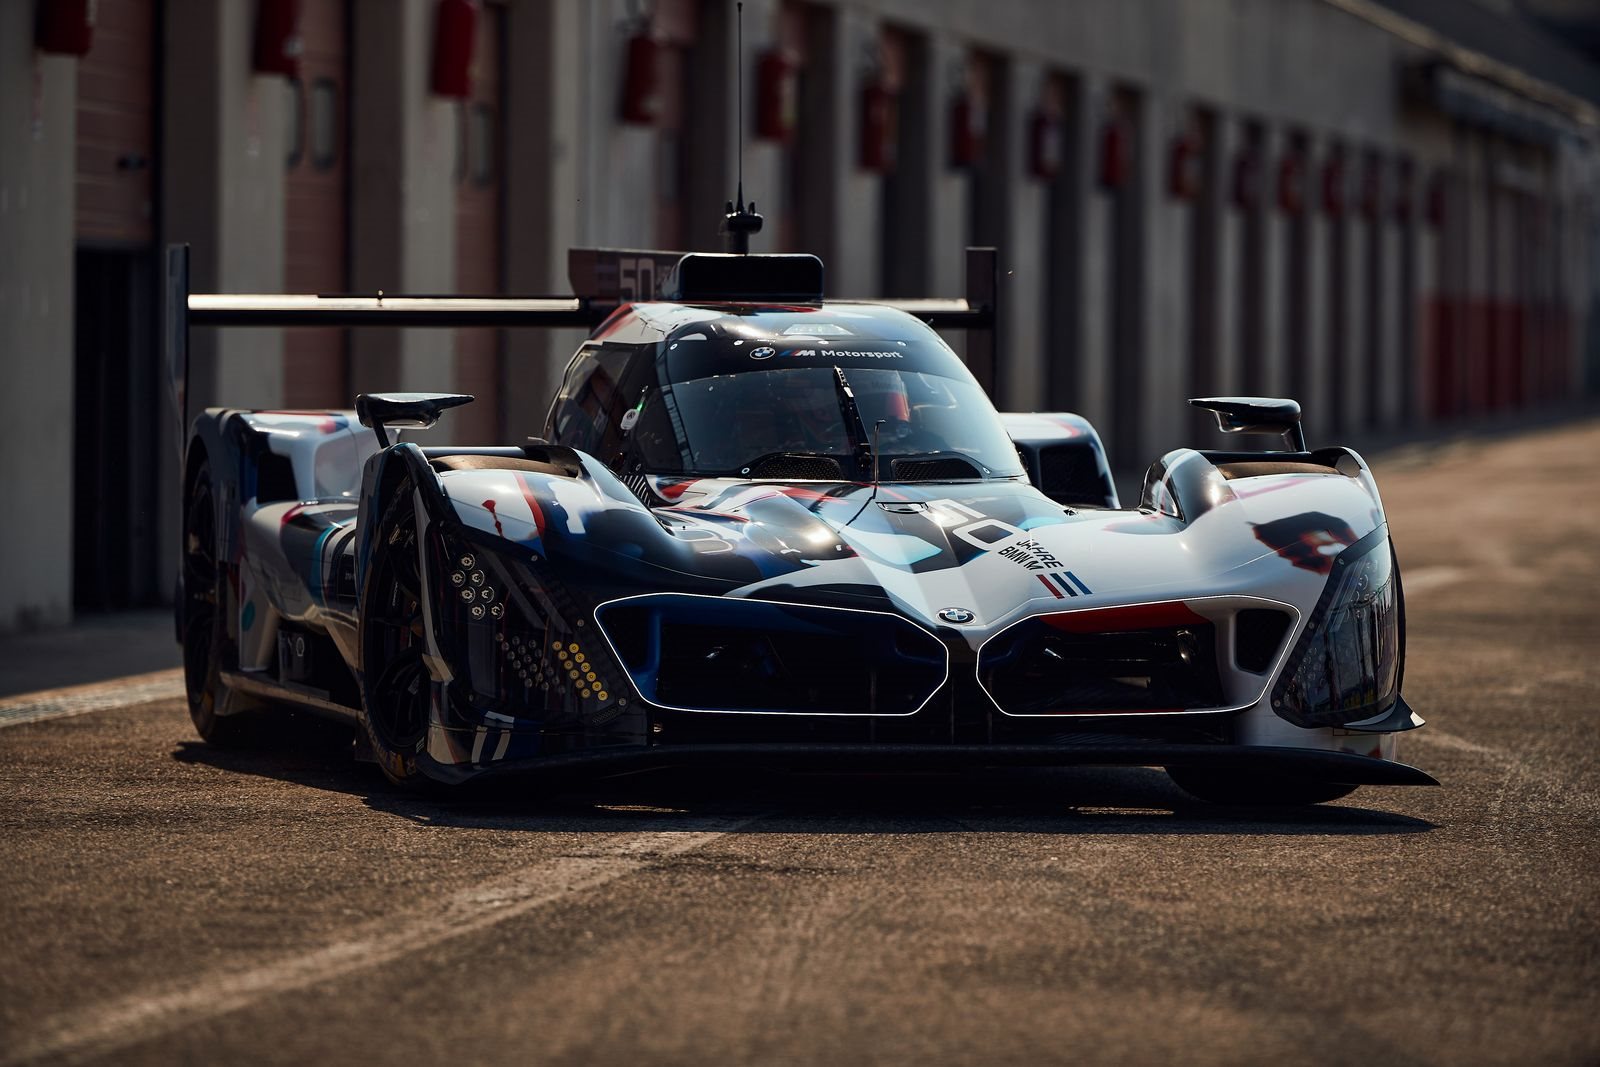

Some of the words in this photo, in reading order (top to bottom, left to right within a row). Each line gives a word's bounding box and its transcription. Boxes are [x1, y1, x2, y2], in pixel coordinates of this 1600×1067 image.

[821, 349, 904, 359] Motorsport
[998, 546, 1032, 565] BMW
[1023, 560, 1045, 571] M
[1016, 539, 1064, 569] JAHRE
